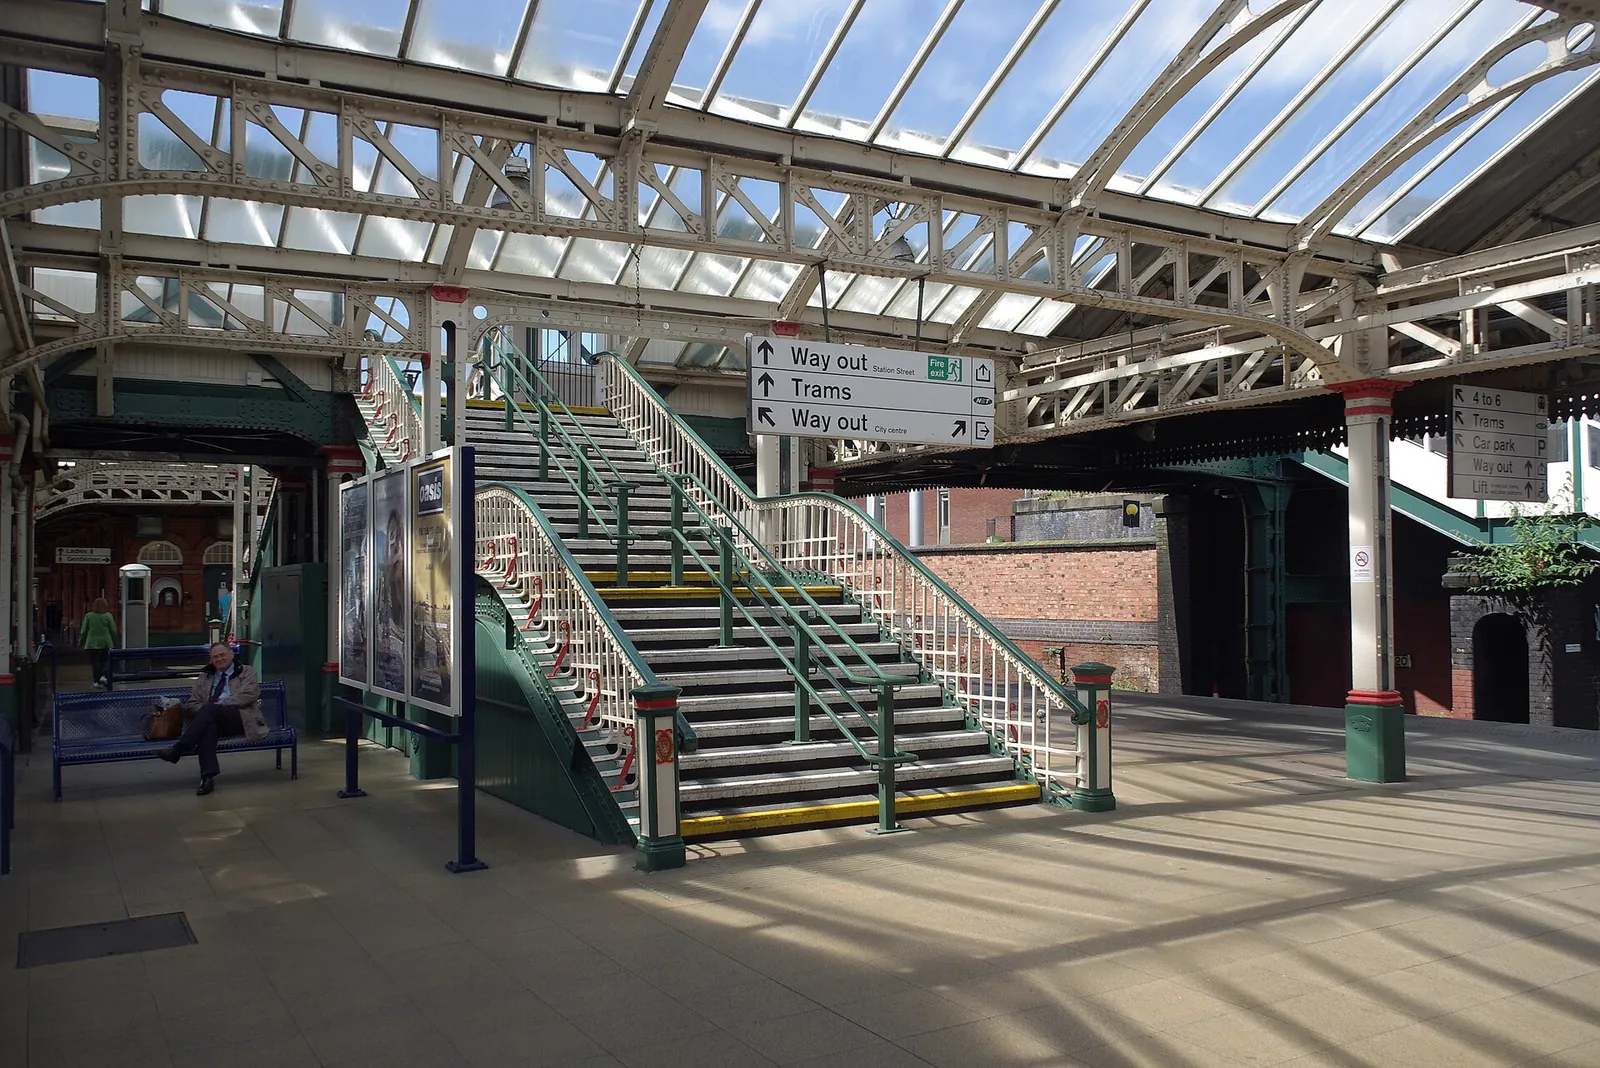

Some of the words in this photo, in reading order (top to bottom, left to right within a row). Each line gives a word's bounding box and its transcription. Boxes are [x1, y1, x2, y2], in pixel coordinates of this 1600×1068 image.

[791, 346, 831, 371] Way
[837, 354, 868, 371] out
[930, 359, 945, 368] Fire
[872, 365, 897, 374] Station
[898, 367, 915, 376] Street
[930, 370, 945, 378] exit
[791, 378, 852, 400] Trams
[1473, 392, 1479, 404] 4
[1483, 393, 1492, 405] to
[1495, 394, 1501, 406] 6
[791, 408, 831, 432] Way
[838, 414, 868, 432] out
[1473, 413, 1505, 429] Trams
[874, 425, 887, 434] City
[887, 427, 908, 435] centre
[1473, 436, 1490, 450] Car
[1493, 439, 1516, 452] park
[1538, 440, 1546, 456] P
[1473, 458, 1494, 475] Way
[1496, 461, 1513, 473] out
[420, 476, 442, 503] oasis
[1473, 480, 1488, 494] Lift
